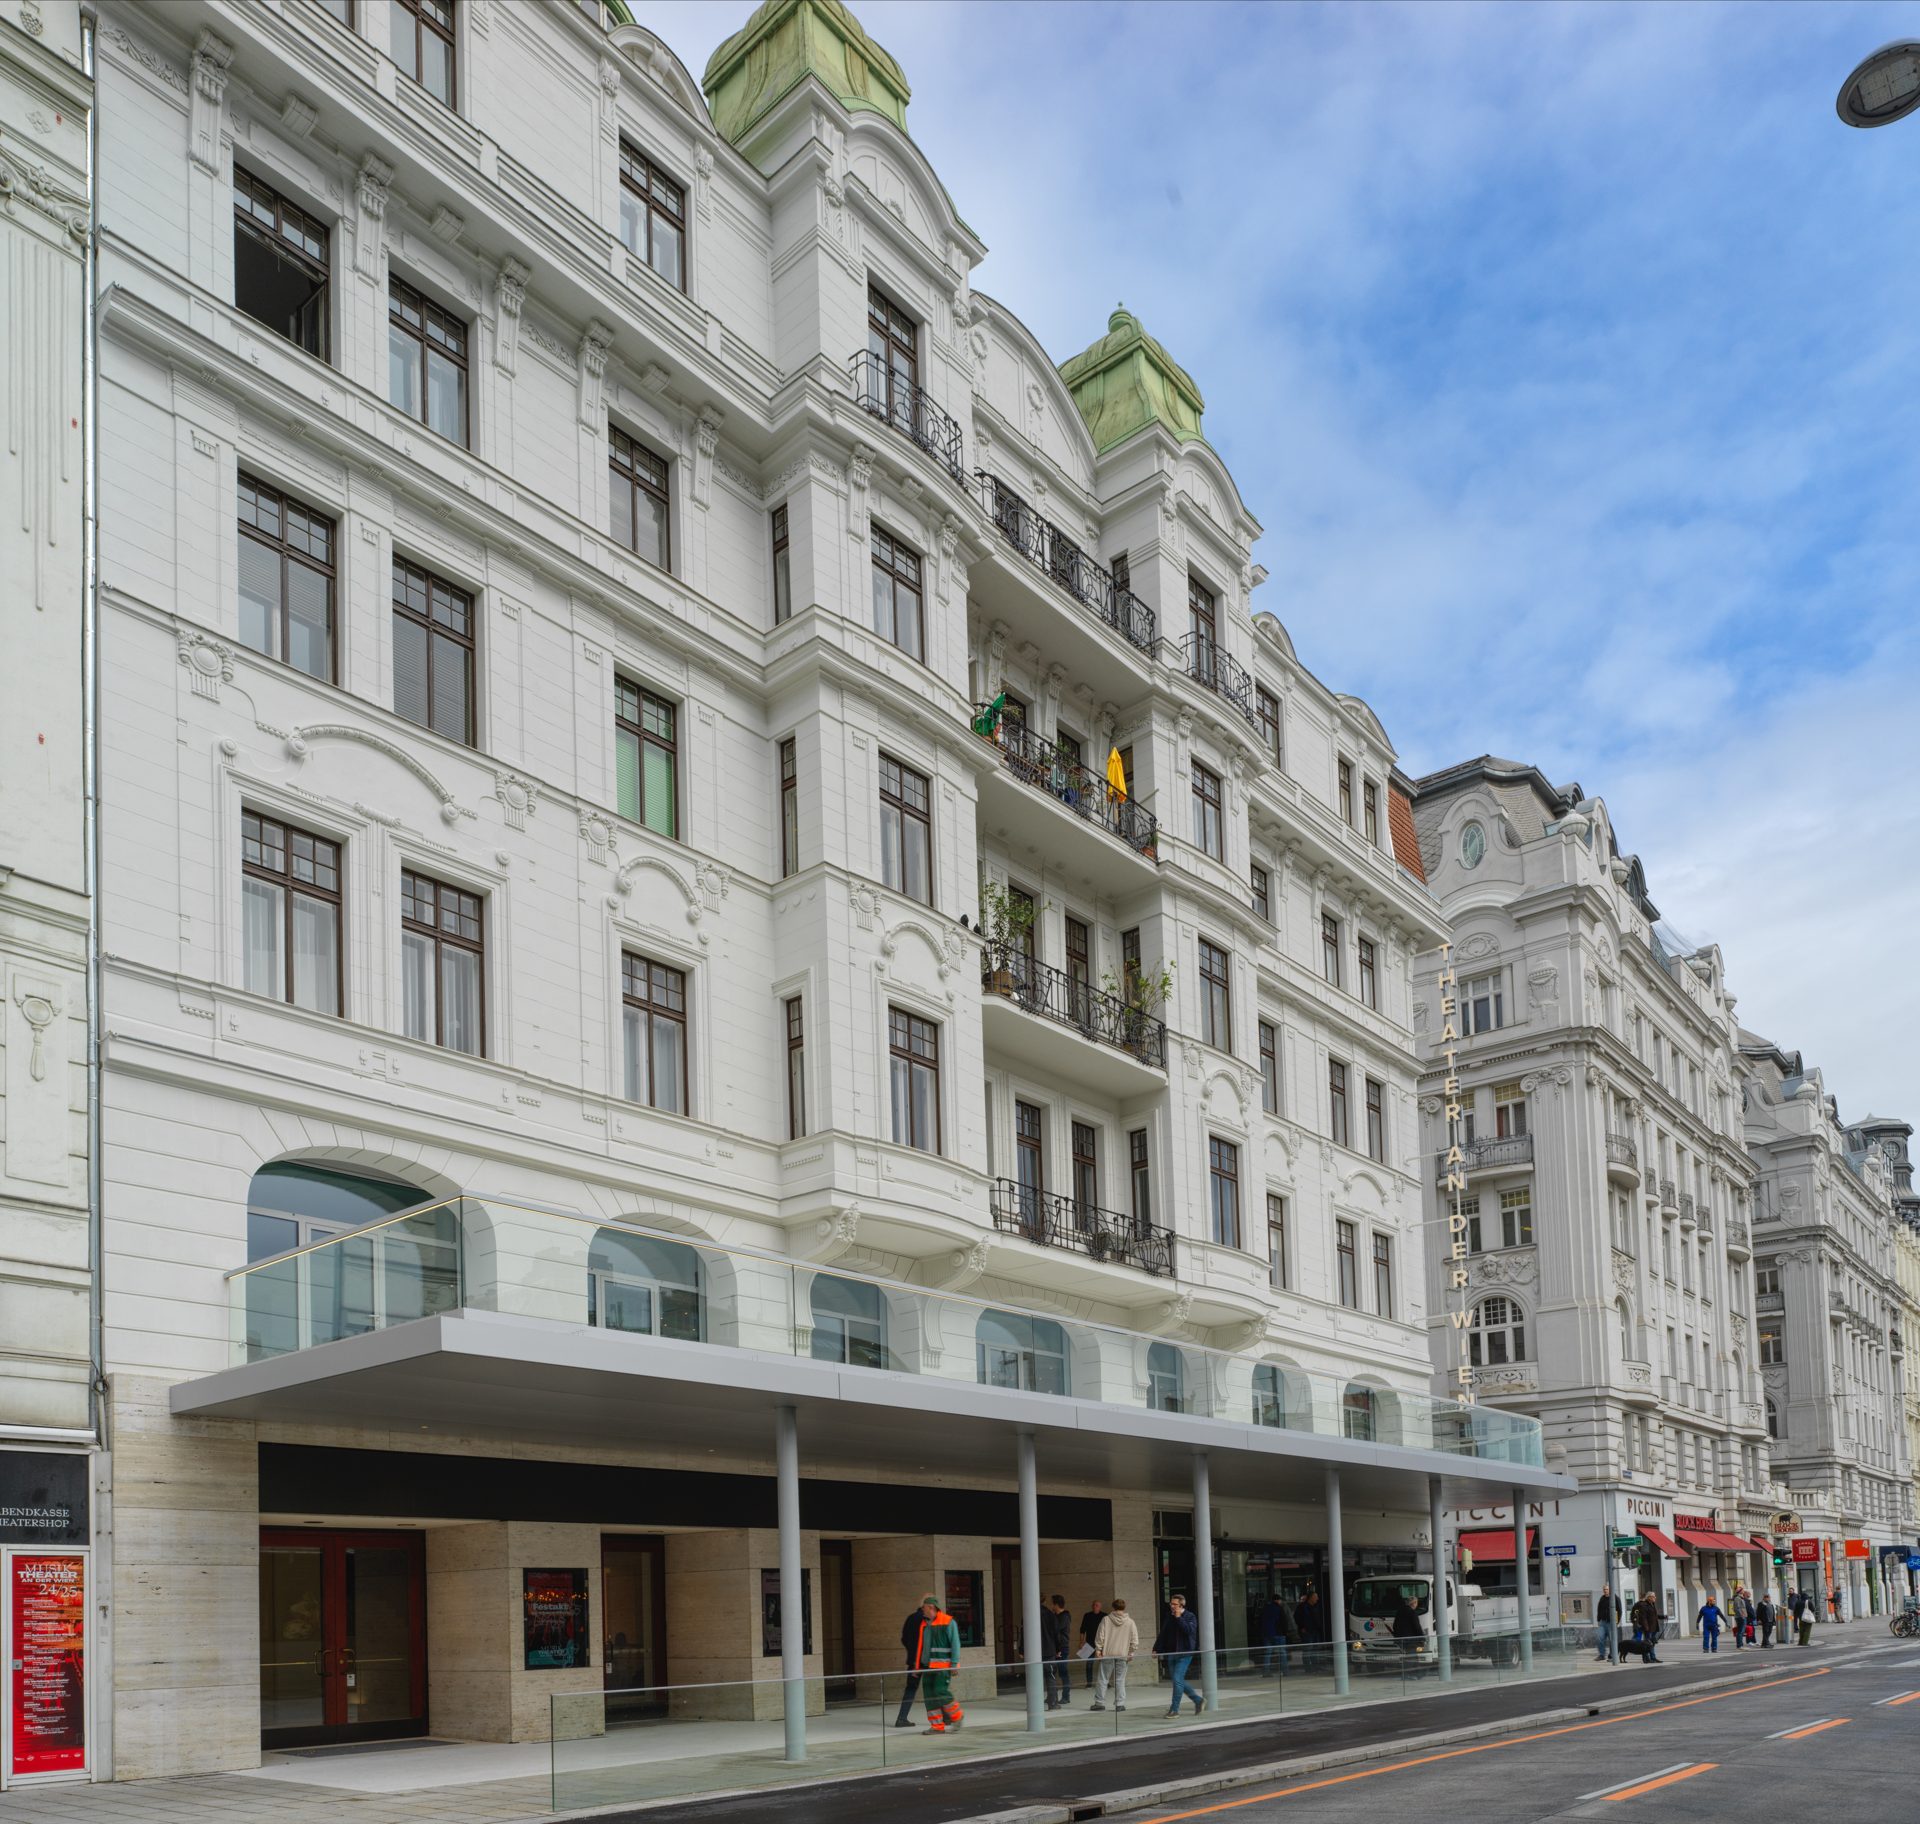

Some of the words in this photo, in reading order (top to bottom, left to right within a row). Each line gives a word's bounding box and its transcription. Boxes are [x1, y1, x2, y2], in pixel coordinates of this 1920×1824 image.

[1438, 944, 1461, 1122] THEATER
[1446, 1146, 1467, 1191] AN
[1449, 1215, 1469, 1288] DER
[1451, 1310, 1475, 1406] WIEN
[0, 1507, 70, 1518] BENDKASSE
[1627, 1497, 1665, 1518] PICCINI
[1675, 1514, 1695, 1529] BLOCK
[1695, 1516, 1714, 1531] HOUSE
[25, 1563, 73, 1572] MUSIK
[39, 1583, 78, 1598] 24/25
